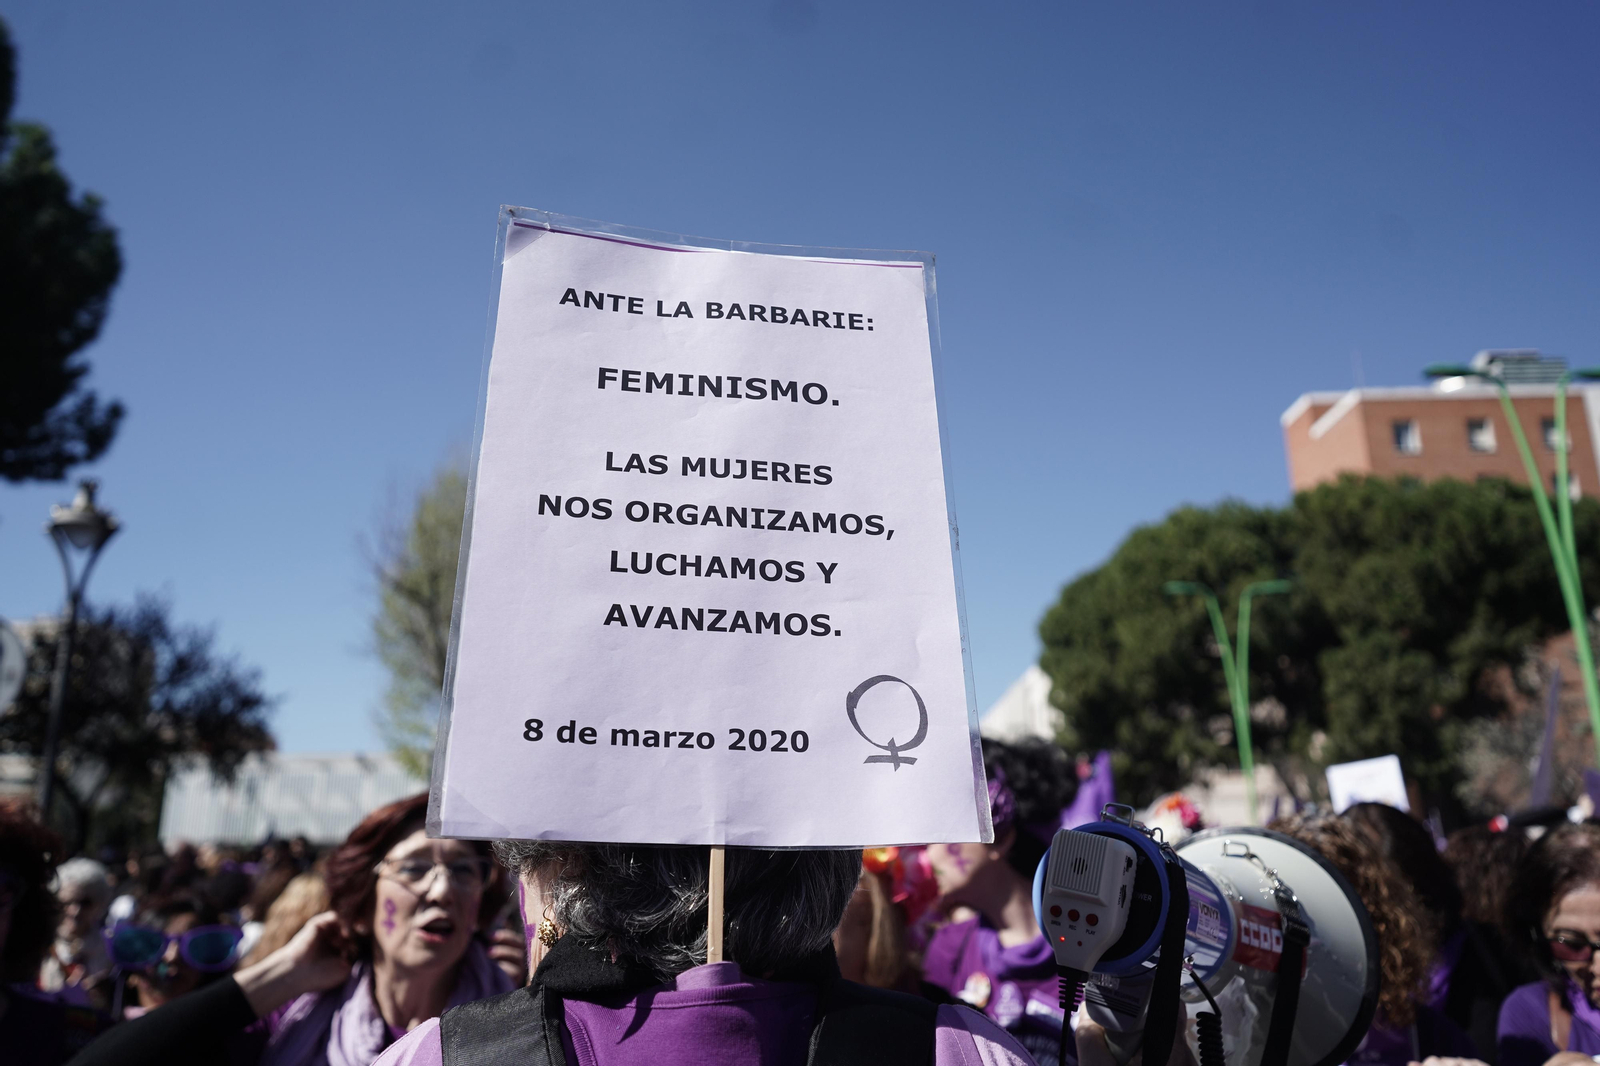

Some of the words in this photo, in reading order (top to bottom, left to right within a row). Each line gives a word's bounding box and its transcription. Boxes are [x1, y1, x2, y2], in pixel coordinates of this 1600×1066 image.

[558, 287, 644, 315] ANTE
[656, 299, 694, 319] LA
[706, 301, 875, 332] BARBARIE:
[597, 366, 840, 407] FEMINISMO.
[605, 451, 669, 475] LAS
[681, 456, 833, 486] MUJERES
[537, 493, 613, 521] NOS
[624, 500, 895, 541] ORGANIZAMOS,
[609, 549, 806, 583] LUCHAMOS
[815, 561, 839, 584] Y
[602, 603, 842, 637] AVANZAMOS.
[522, 718, 544, 742] 8
[556, 719, 598, 746] de
[610, 728, 716, 750] marzo
[728, 727, 810, 753] 2020
